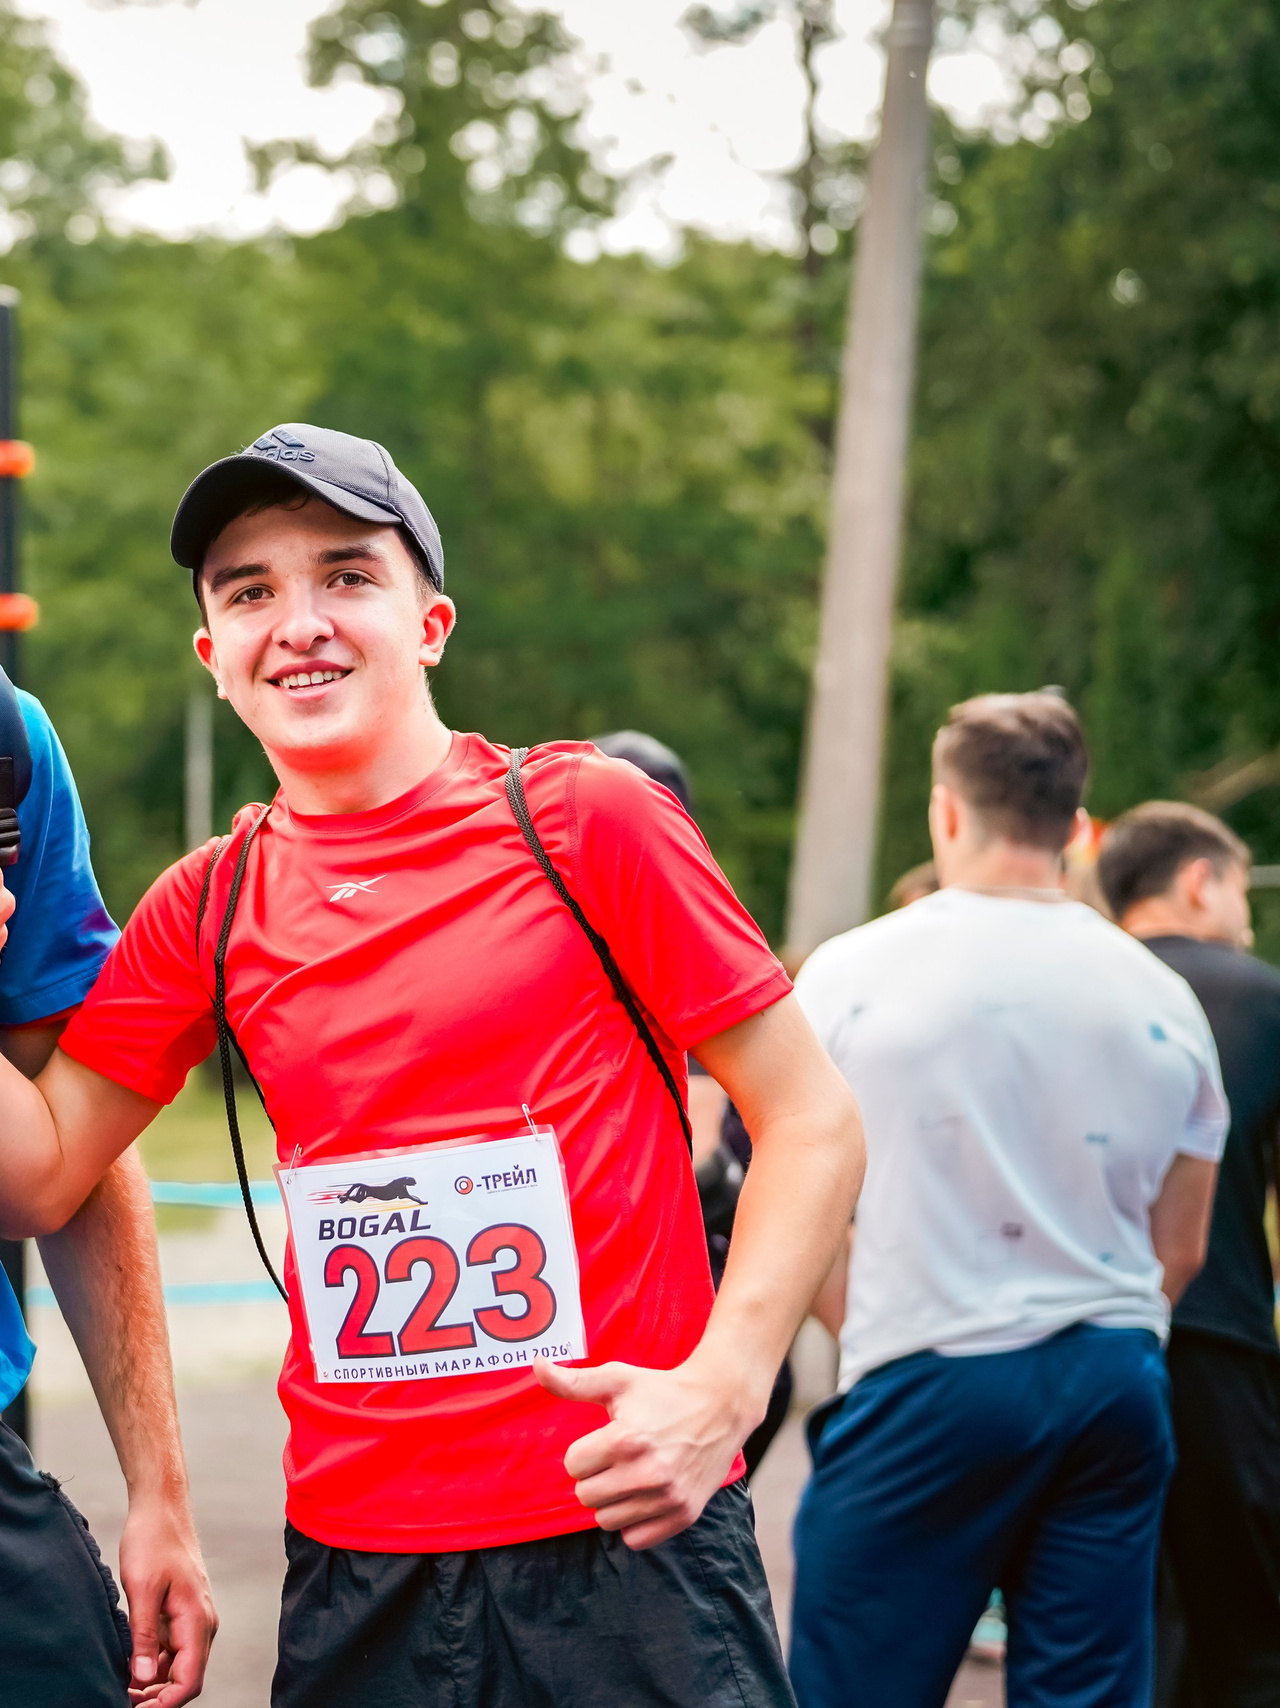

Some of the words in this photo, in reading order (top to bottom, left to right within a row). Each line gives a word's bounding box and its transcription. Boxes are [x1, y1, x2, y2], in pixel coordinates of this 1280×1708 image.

[318, 1209, 432, 1241] BOGAL
[323, 1222, 557, 1360] 223
[333, 1362, 430, 1380] СПОРТИВНЫЙ
[434, 1350, 528, 1374] МАРАФОН
